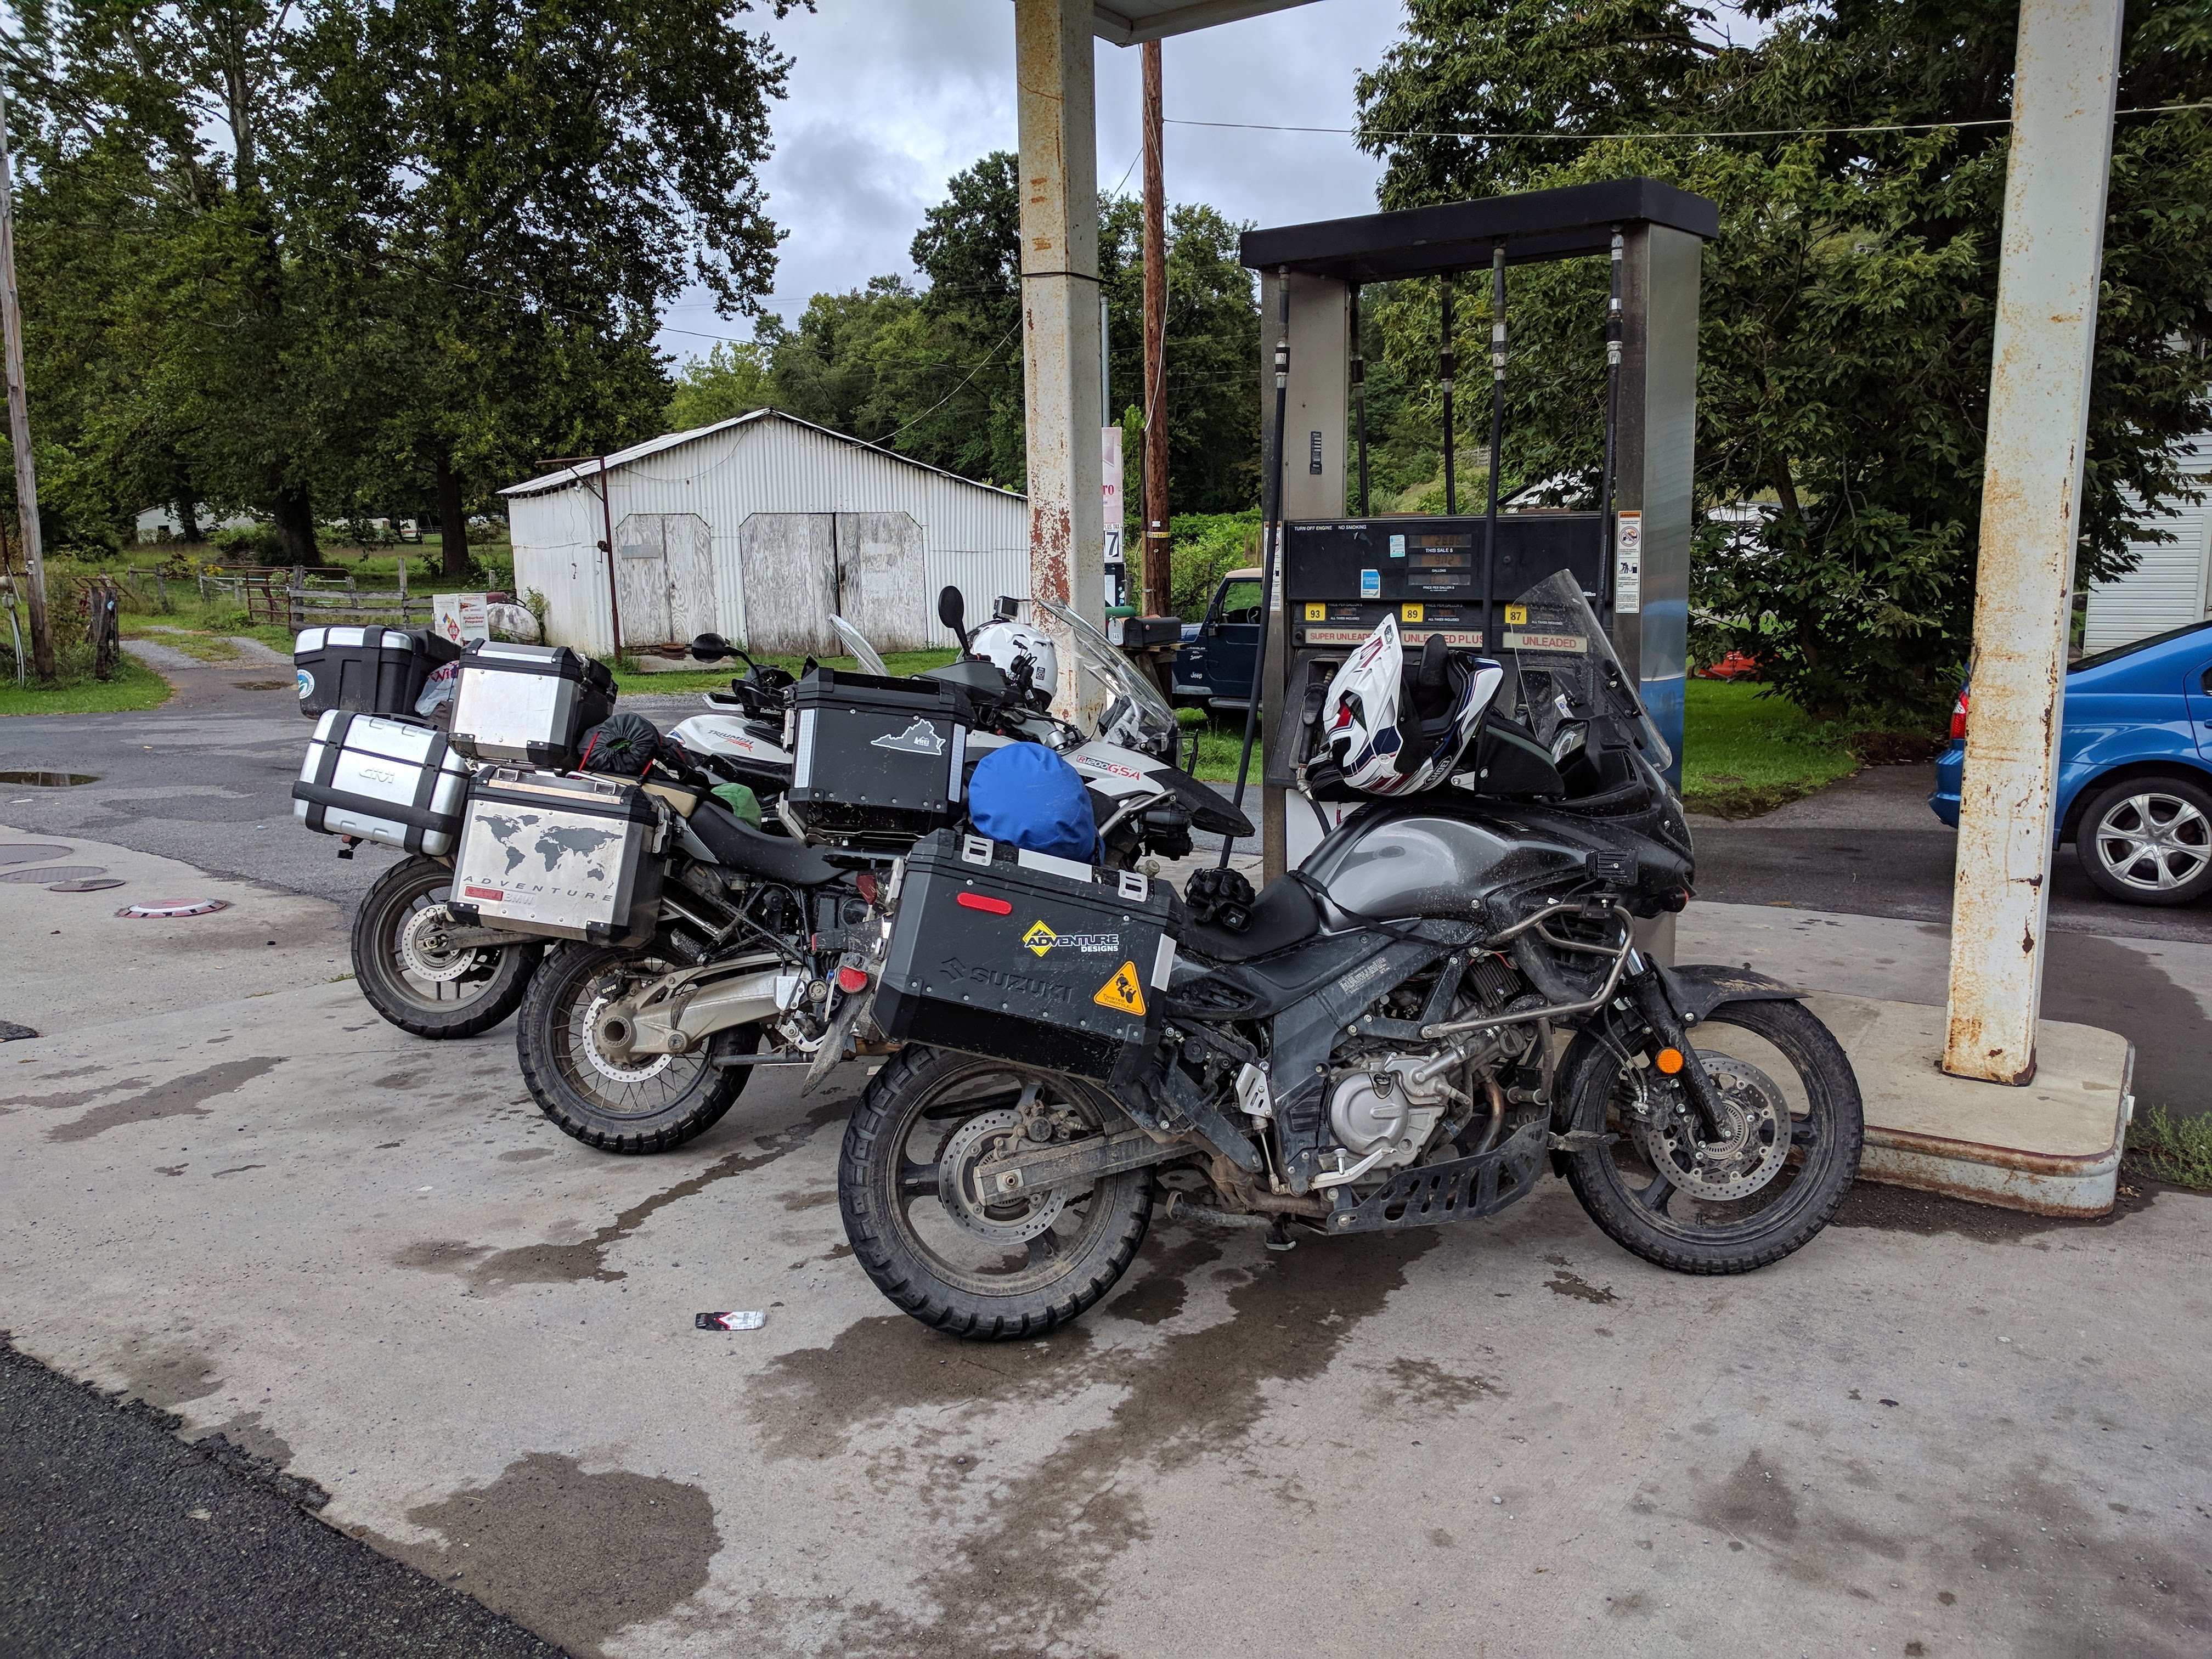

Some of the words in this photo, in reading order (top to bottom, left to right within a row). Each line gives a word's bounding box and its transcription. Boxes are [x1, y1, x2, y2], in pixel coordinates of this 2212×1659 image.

[1102, 484, 1114, 495] ro
[1107, 532, 1118, 556] 7
[1310, 610, 1320, 618] 93
[1407, 610, 1418, 618] 89
[1510, 612, 1521, 620] 87
[1404, 634, 1456, 644] UNLEED
[1522, 636, 1577, 648] UNLEADED
[707, 730, 754, 744] TRIUMPH
[727, 737, 753, 752] TIGER
[1426, 760, 1451, 782] SHOEI
[462, 875, 613, 902] ADVENTURE
[504, 893, 534, 905] BMW
[1024, 934, 1120, 948] ADVENTURE
[601, 984, 617, 994] BMW
[969, 967, 1073, 1003] SUZUKI
[1103, 993, 1125, 1003] TWISTED
